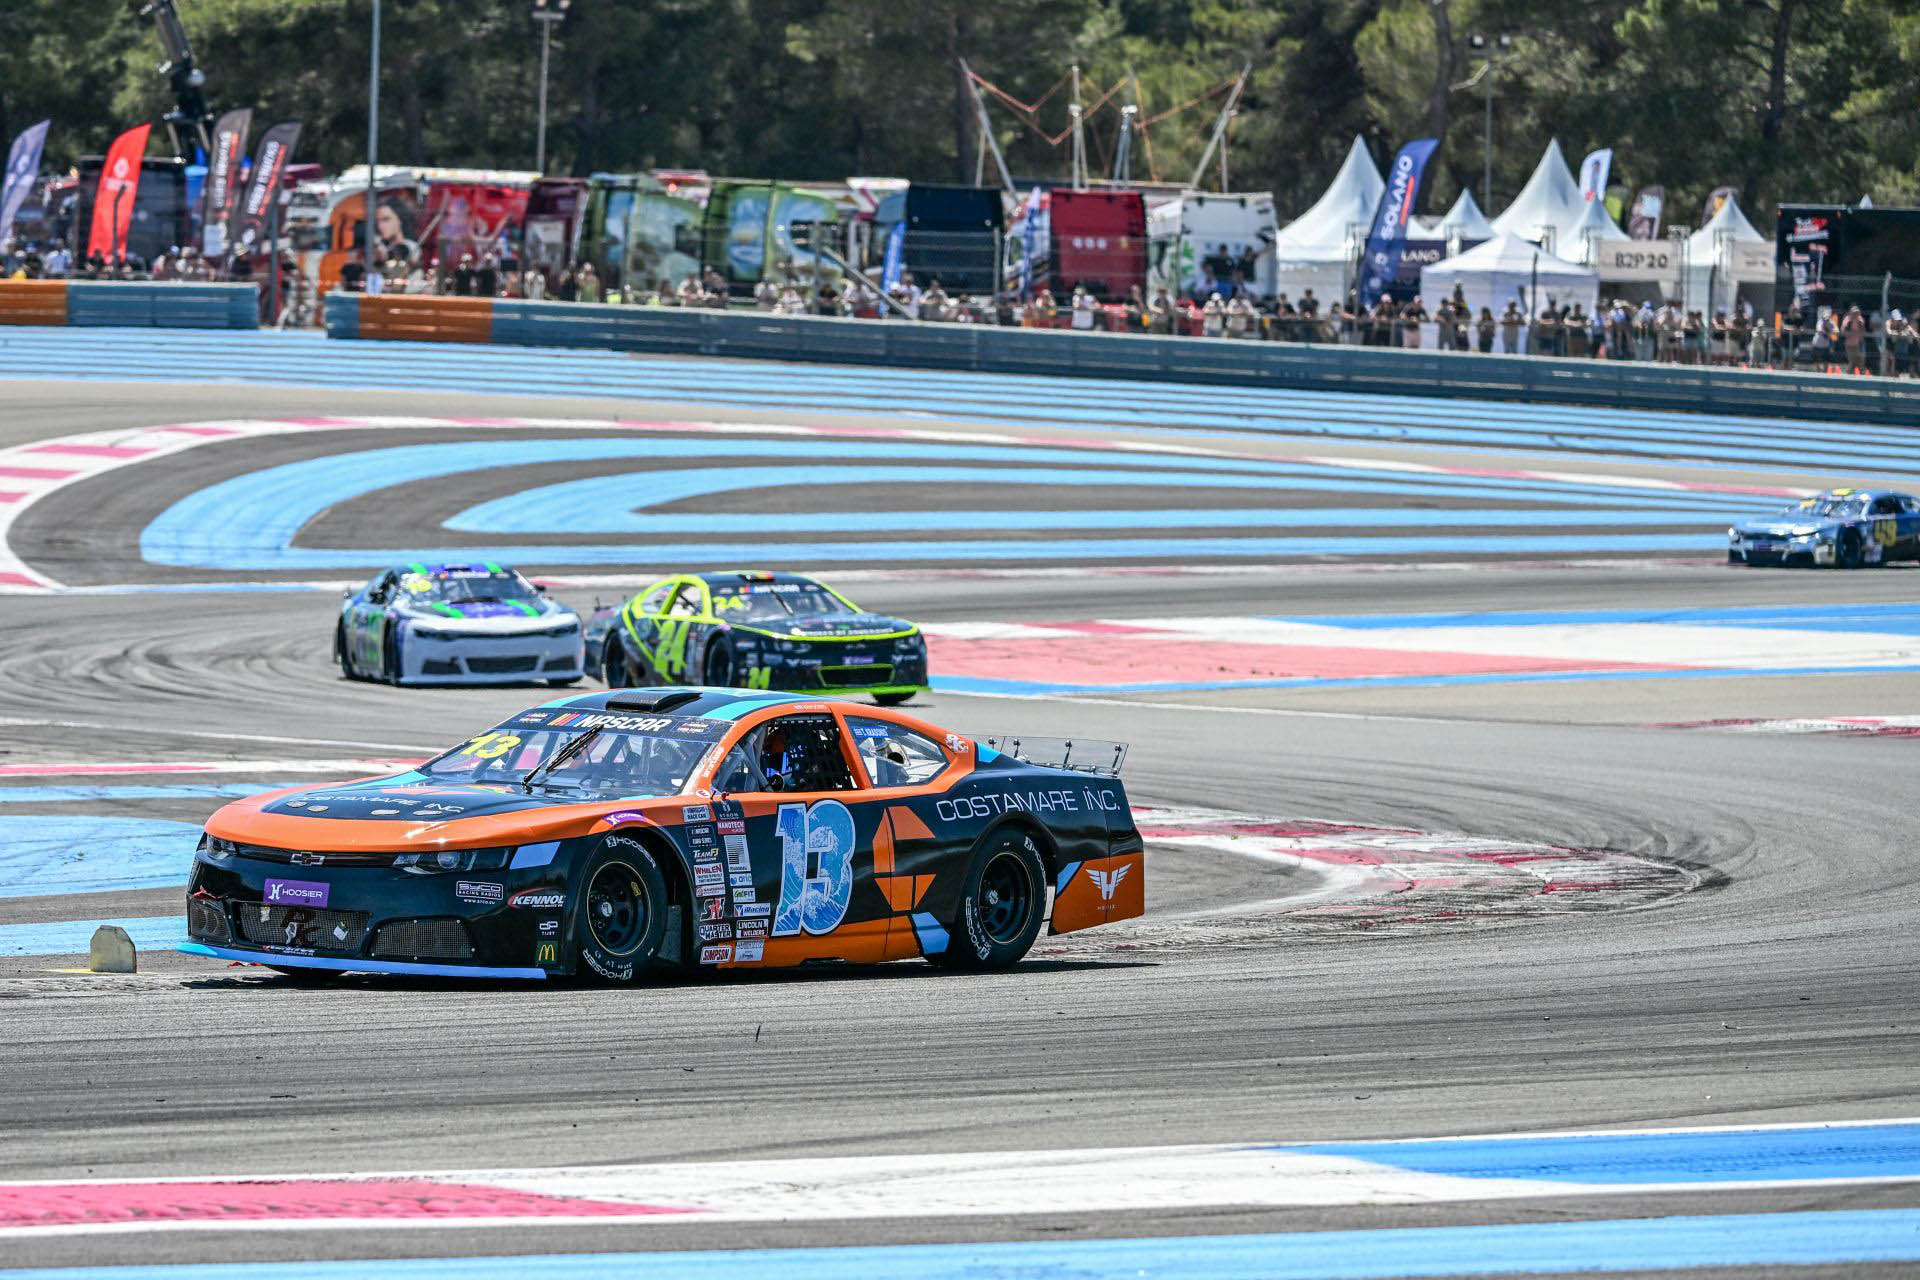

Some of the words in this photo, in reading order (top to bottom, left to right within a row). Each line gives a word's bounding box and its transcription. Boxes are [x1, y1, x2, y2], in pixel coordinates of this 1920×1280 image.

[1380, 155, 1413, 240] SOLANO
[1400, 249, 1440, 262] LANO
[655, 620, 690, 673] 24
[574, 714, 673, 732] NASCAR
[460, 733, 521, 759] 13
[936, 790, 1078, 822] COSTAMARE
[1082, 789, 1121, 811] INC.
[616, 836, 656, 868] HOOSIER
[771, 799, 856, 936] 13
[282, 888, 323, 899] HOOSIER
[512, 896, 564, 905] KENNOL
[700, 924, 730, 935] QUARTER
[705, 930, 731, 940] MASTER
[738, 920, 763, 929] LINCOLN
[965, 896, 981, 952] HOOSIER
[583, 948, 624, 980] HOOSIER
[703, 948, 730, 961] SIMPSON
